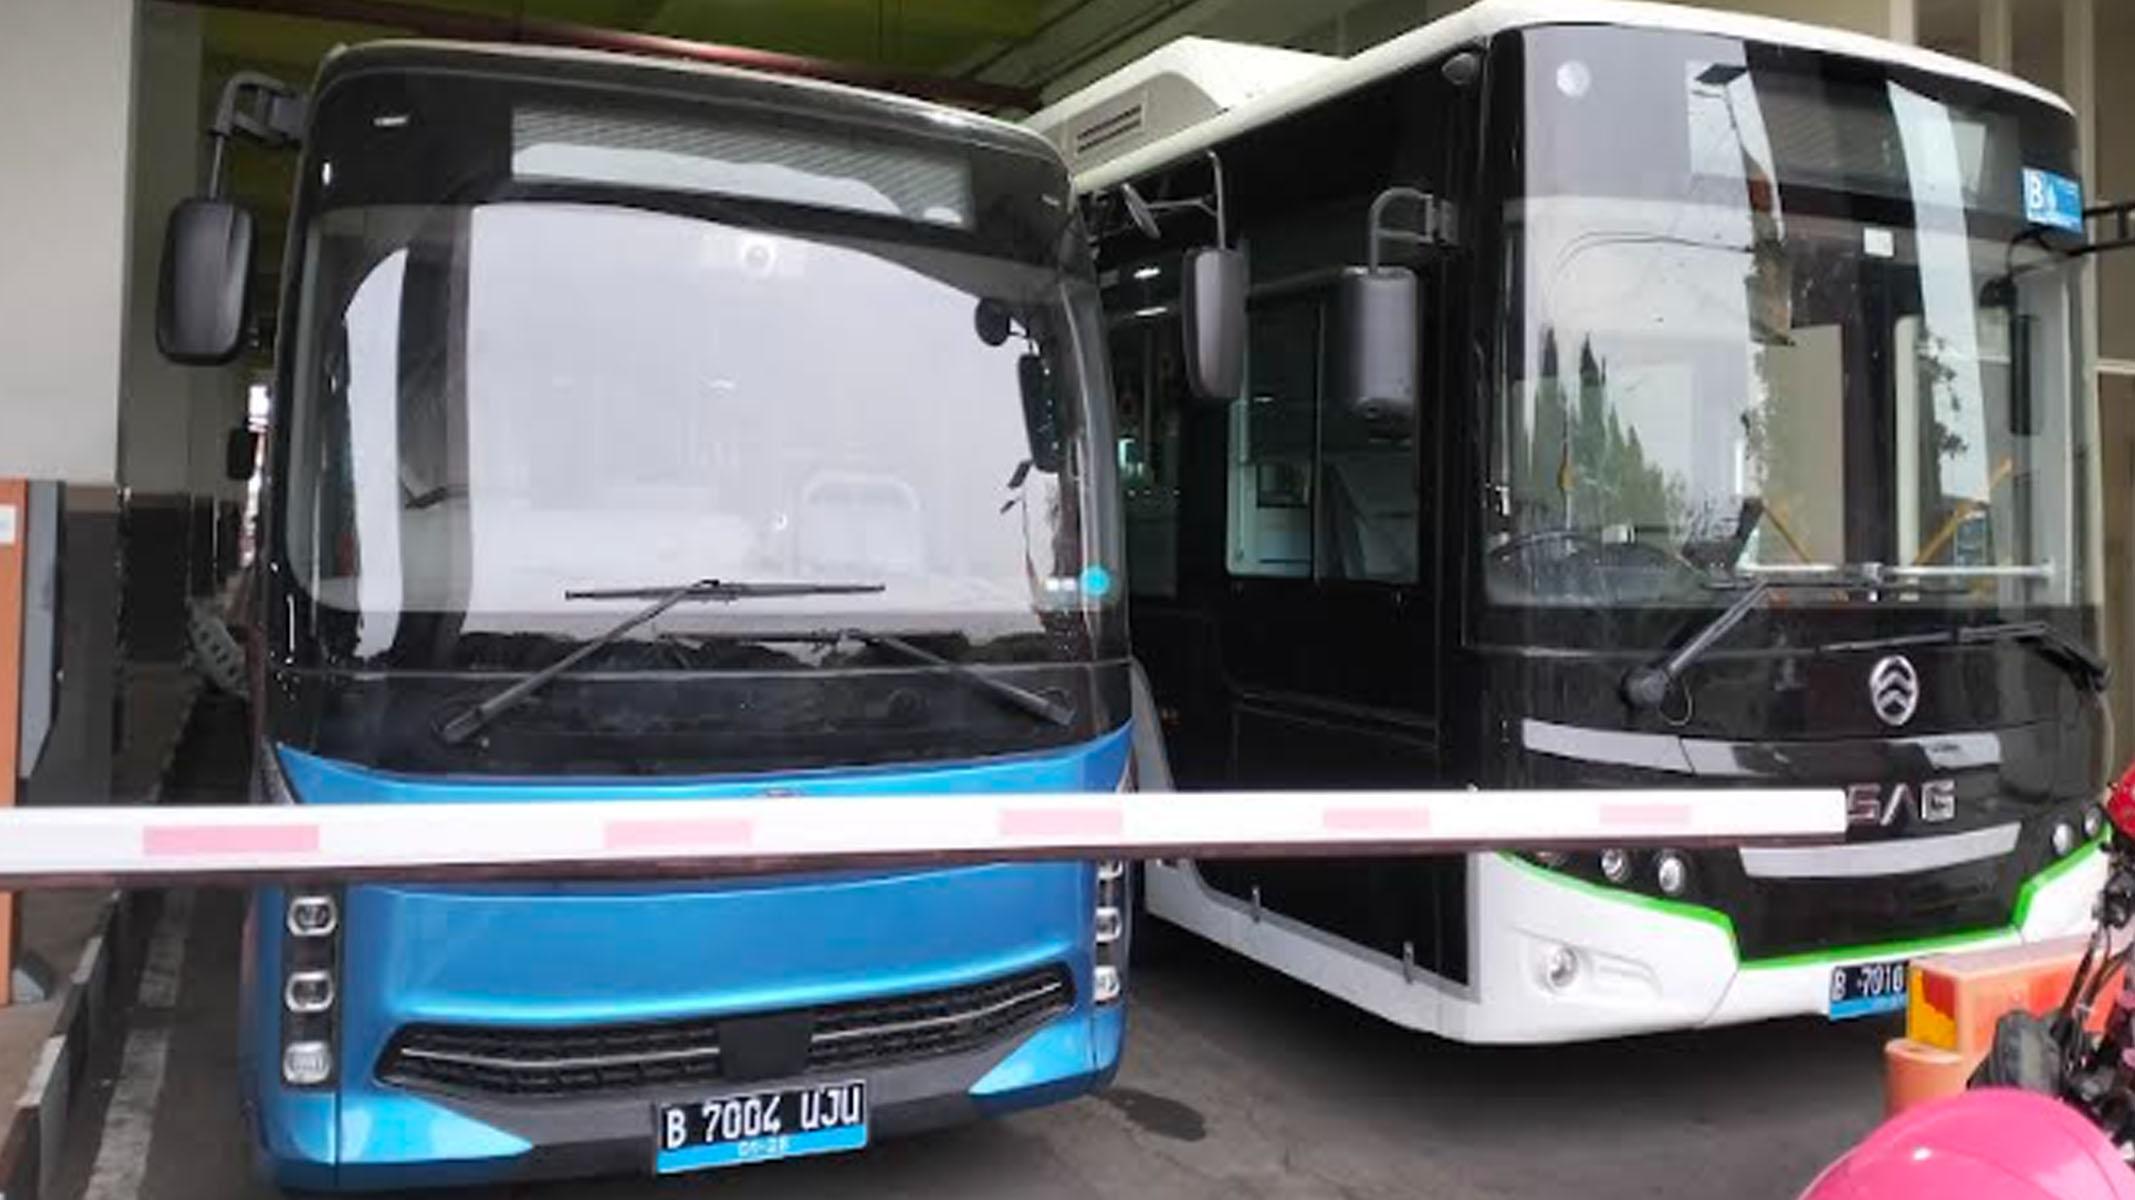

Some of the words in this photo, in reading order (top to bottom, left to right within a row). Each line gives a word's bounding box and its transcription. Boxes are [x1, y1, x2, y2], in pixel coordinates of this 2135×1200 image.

[2027, 173, 2044, 209] B
[1831, 969, 1847, 1001] B
[666, 1109, 686, 1149] B
[702, 1096, 781, 1142] 7004
[801, 1086, 861, 1130] UJU
